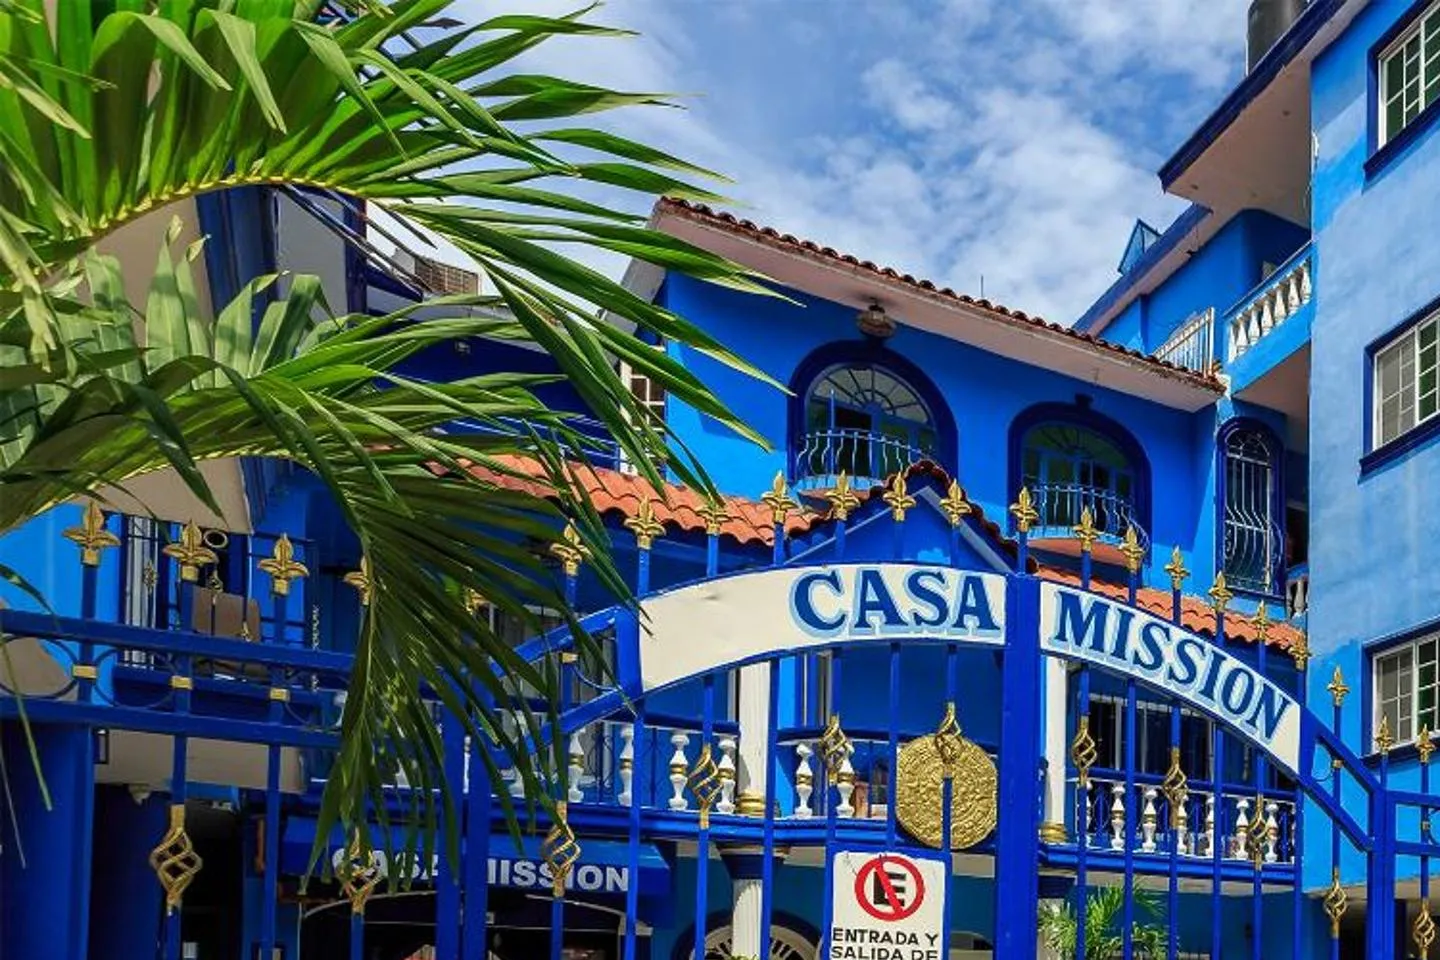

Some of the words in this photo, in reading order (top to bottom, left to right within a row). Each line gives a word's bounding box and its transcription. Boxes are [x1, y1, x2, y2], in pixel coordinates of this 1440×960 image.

[790, 567, 1003, 638] CASA
[1051, 590, 1292, 744] MISSION
[832, 927, 919, 945] ENTRADA
[925, 932, 939, 947] Y
[831, 946, 904, 960] SALIDA
